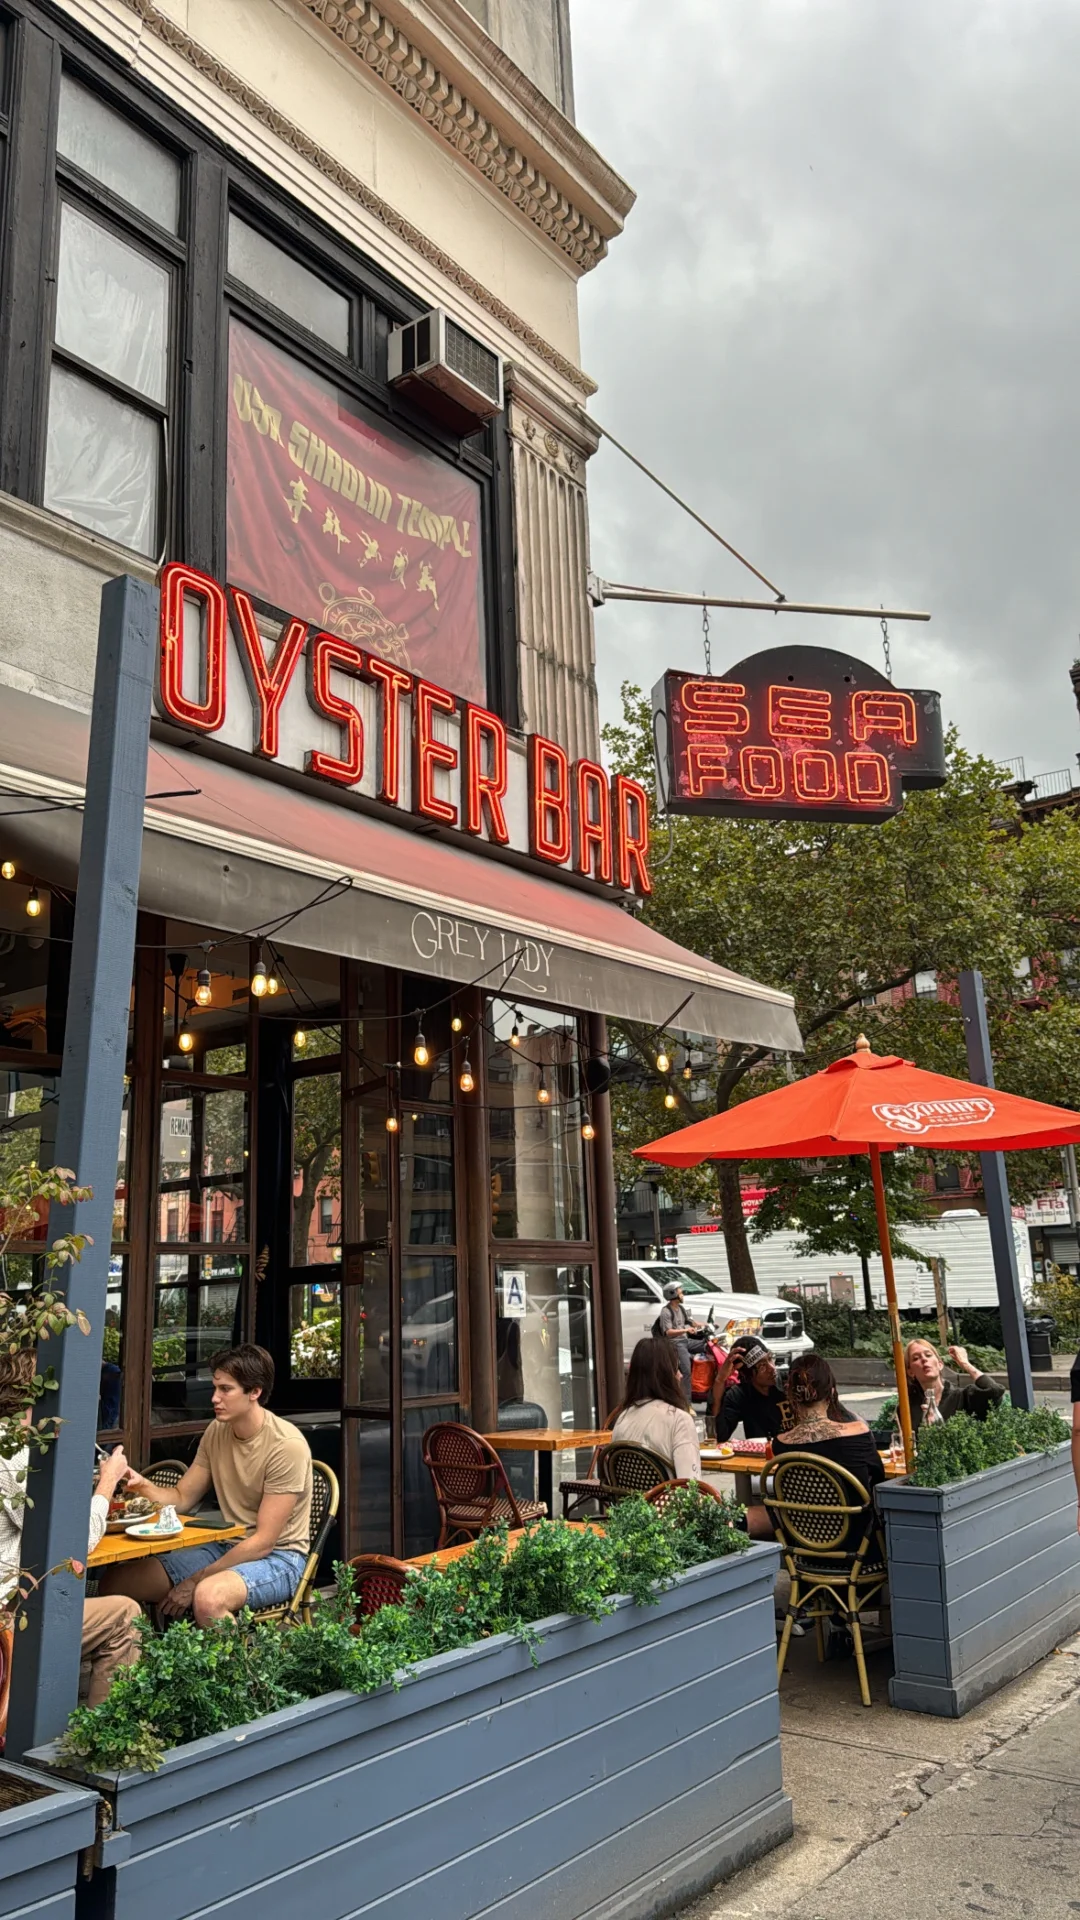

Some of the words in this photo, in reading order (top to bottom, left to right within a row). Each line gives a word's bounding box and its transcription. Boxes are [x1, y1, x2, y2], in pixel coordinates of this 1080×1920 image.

[233, 373, 285, 448] USA
[288, 420, 393, 524] SHAOLIN
[157, 560, 509, 845] OYSTER
[527, 733, 653, 896] BAR
[681, 680, 918, 744] SEA
[686, 744, 891, 803] FOOD
[411, 911, 490, 961] GREY
[500, 933, 554, 993] LADY
[928, 1114, 979, 1124] BREWERY
[690, 1225, 718, 1234] SHOP
[508, 1276, 522, 1304] A
